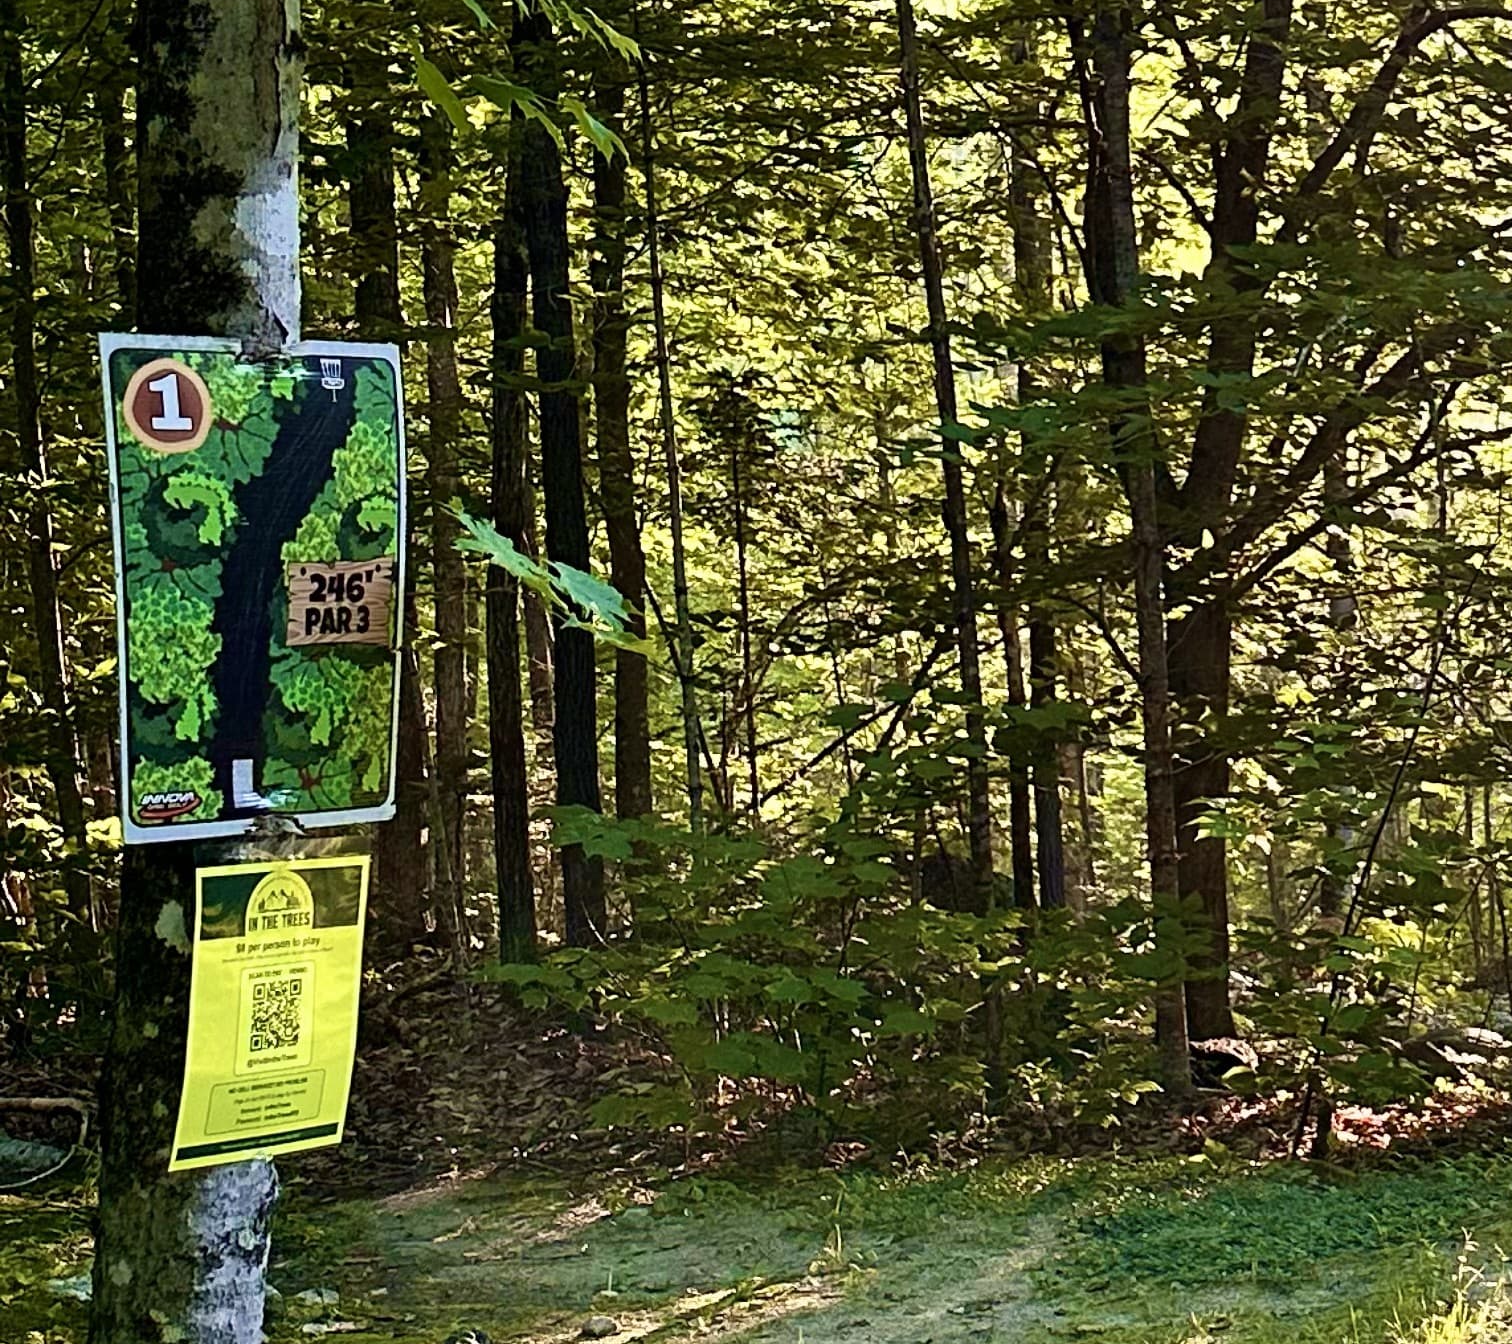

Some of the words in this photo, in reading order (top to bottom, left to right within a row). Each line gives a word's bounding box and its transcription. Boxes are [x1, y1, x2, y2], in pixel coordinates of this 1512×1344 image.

[149, 374, 193, 431] 1
[309, 570, 374, 603] 246'
[305, 606, 352, 635] PAR
[357, 605, 370, 633] 3
[141, 792, 195, 805] INNOVA
[248, 917, 258, 931] IN
[262, 914, 278, 930] THE
[282, 912, 310, 927] TREES
[263, 940, 291, 952] person
[303, 937, 320, 947] play
